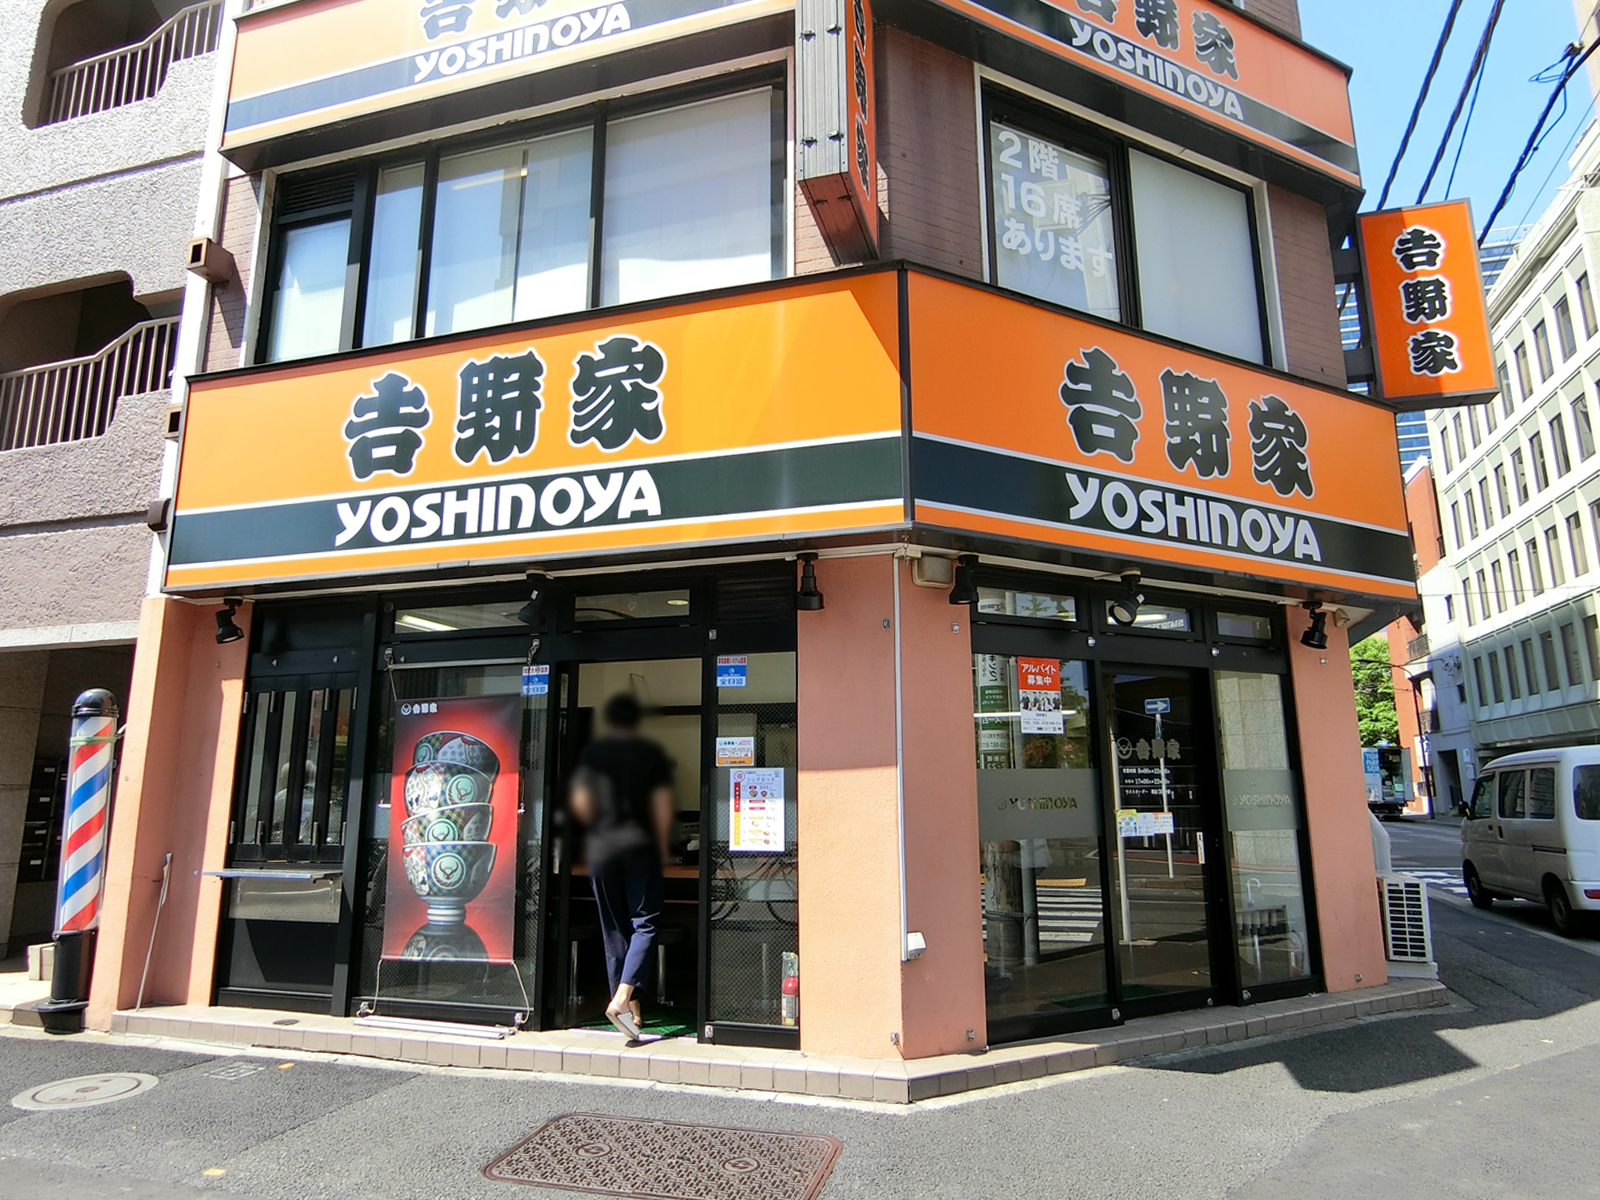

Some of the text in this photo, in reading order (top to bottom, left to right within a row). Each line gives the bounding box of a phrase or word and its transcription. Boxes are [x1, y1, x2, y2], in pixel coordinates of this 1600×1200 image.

[413, 3, 631, 84] YOSHINOYA
[1069, 17, 1244, 121] YOSHINOYA
[998, 130, 1059, 181] 2階
[1001, 173, 1084, 229] 16席
[1002, 217, 1113, 278] あります
[1392, 225, 1463, 377] 吉野家
[343, 334, 665, 481] 吉野家
[1059, 346, 1316, 500] 吉野家
[334, 469, 662, 547] YOSHINOYA
[1065, 472, 1322, 562] YOSHINOYA
[1020, 663, 1057, 675] アルバイト
[1027, 675, 1052, 686] 募集中
